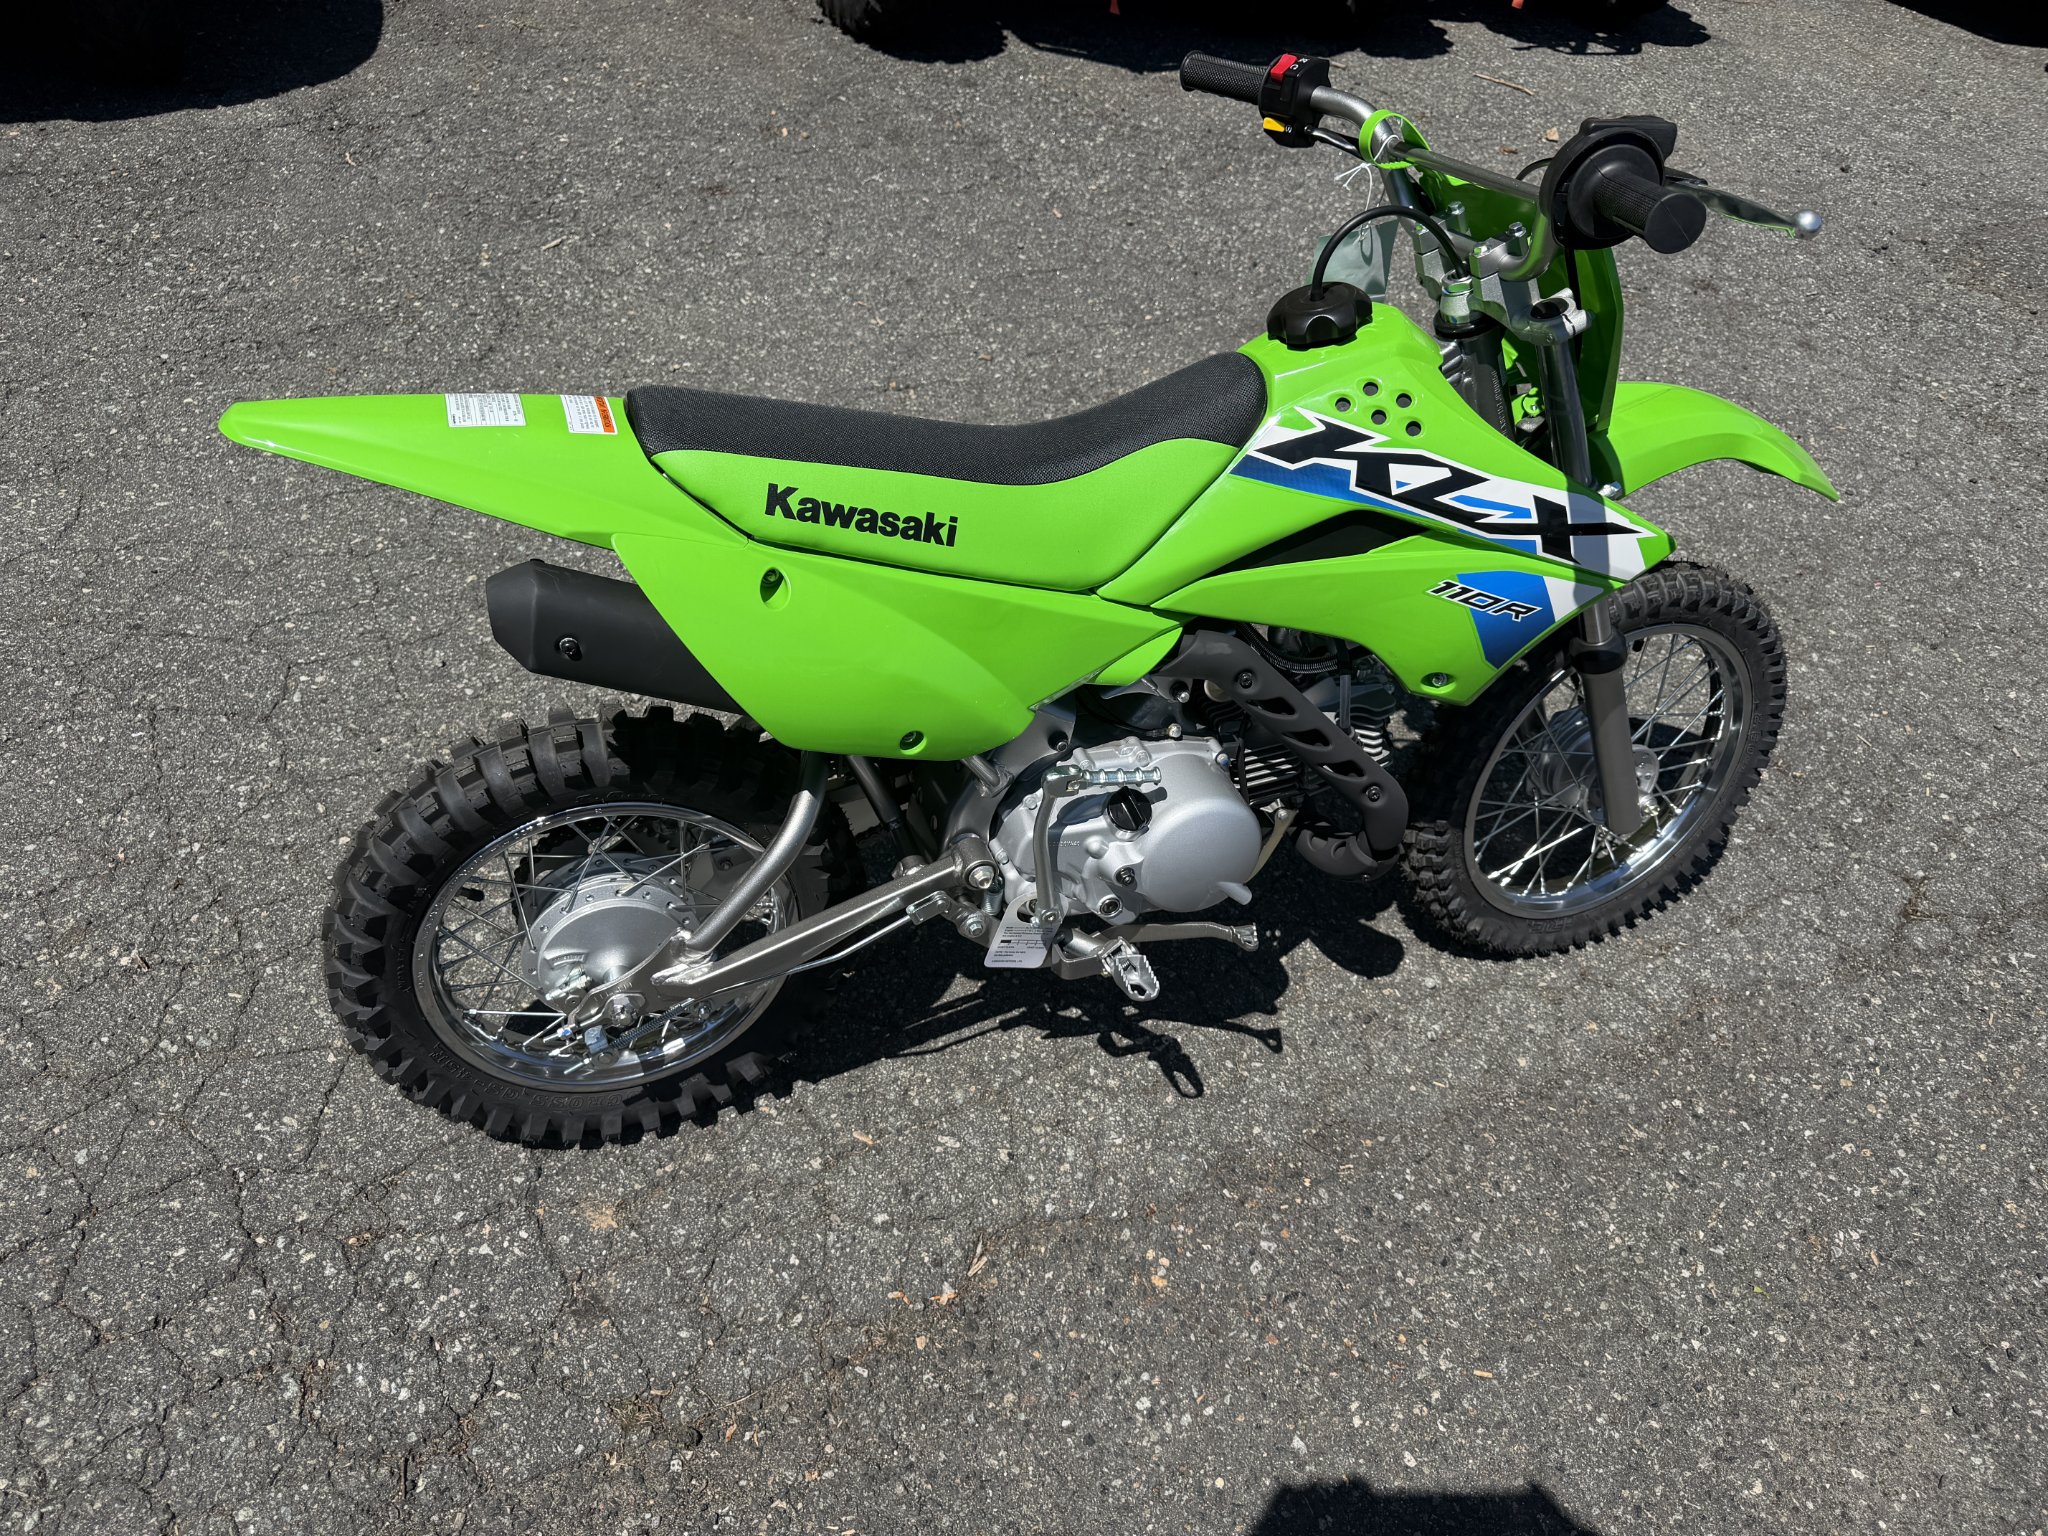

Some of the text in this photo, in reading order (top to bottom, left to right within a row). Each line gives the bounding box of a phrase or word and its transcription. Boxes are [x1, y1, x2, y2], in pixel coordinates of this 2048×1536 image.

[765, 483, 958, 547] Kawasaki
[1254, 417, 1643, 565] KLX
[1427, 580, 1541, 621] 110R
